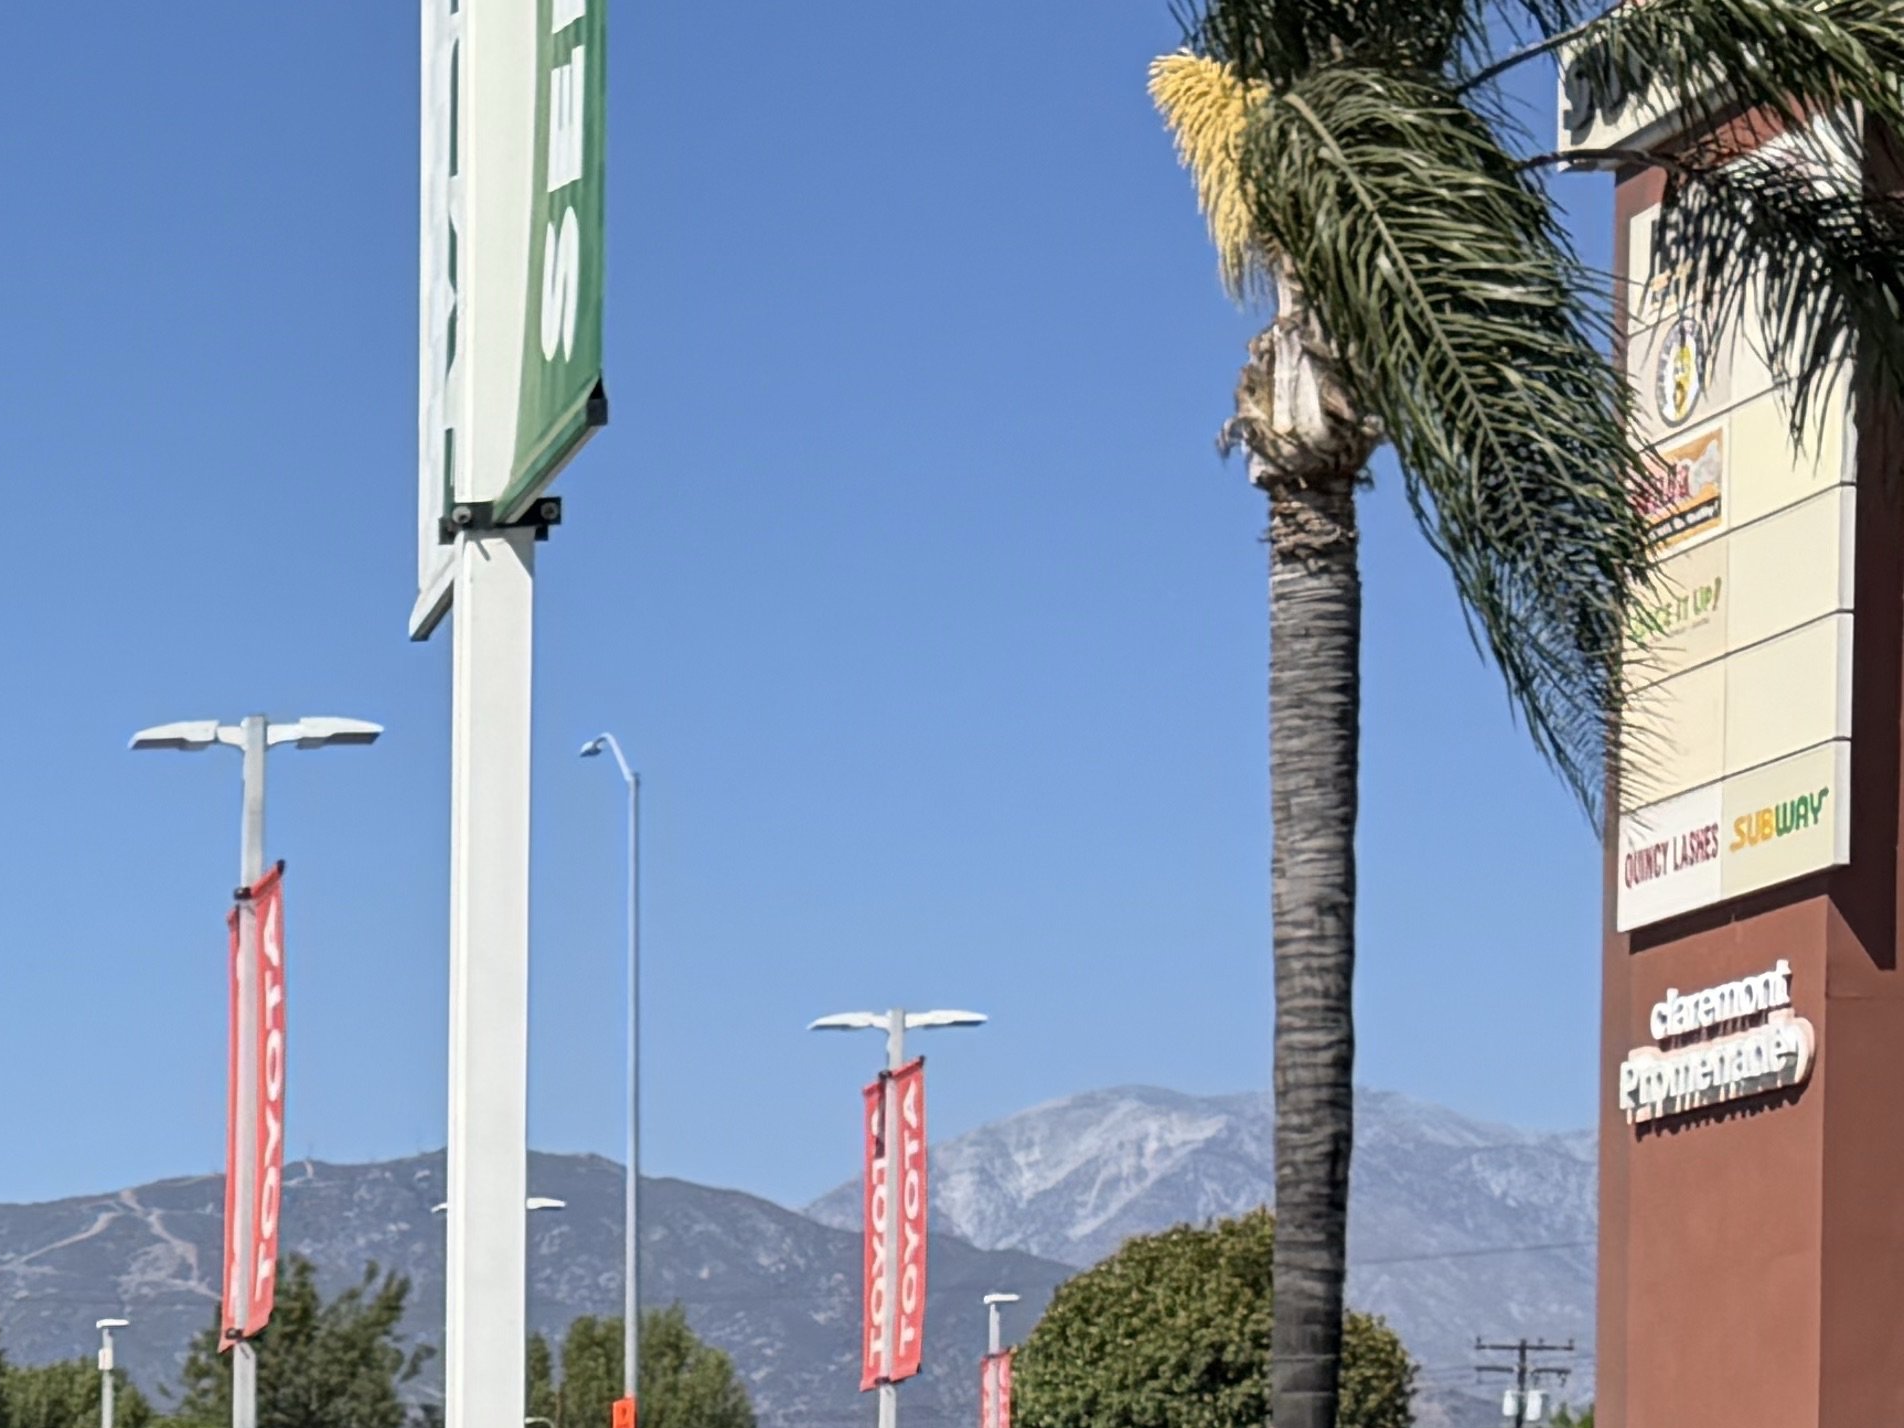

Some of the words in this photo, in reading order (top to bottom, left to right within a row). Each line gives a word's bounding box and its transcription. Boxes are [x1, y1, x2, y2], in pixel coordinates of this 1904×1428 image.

[1624, 841, 1669, 889] QUINCY
[1673, 823, 1719, 871] LASHES
[1729, 787, 1829, 853] SUBWAY
[254, 896, 282, 1303] TOYOTA
[899, 1079, 919, 1357] TOYOTA
